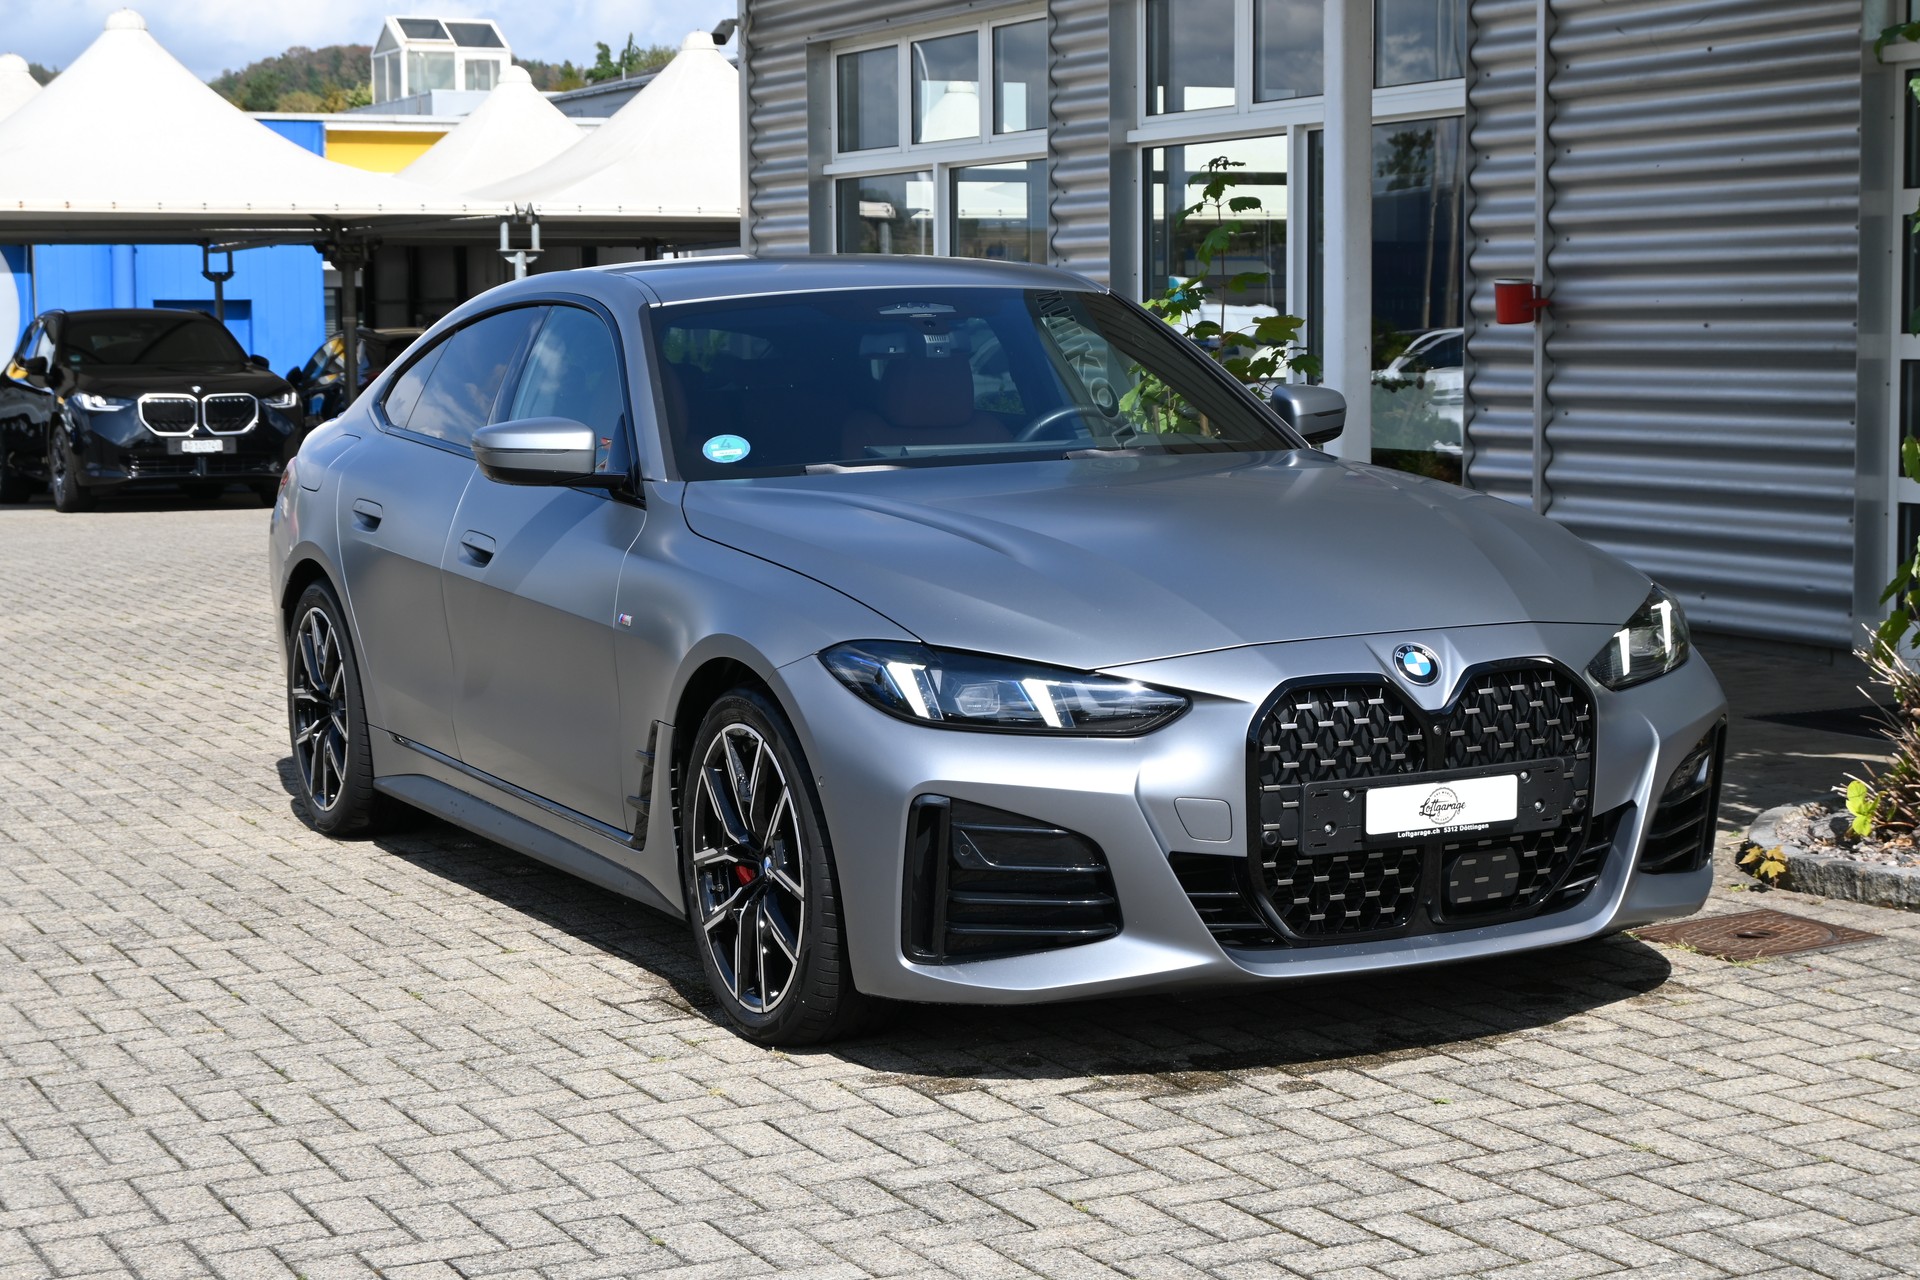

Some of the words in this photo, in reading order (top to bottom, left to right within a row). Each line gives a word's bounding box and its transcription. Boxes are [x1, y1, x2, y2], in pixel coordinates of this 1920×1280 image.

[1396, 645, 1434, 660] BMW
[1419, 797, 1466, 817] Loftgarage
[1397, 828, 1440, 839] Loftgarage.ch
[1459, 823, 1489, 832] Döttingen
